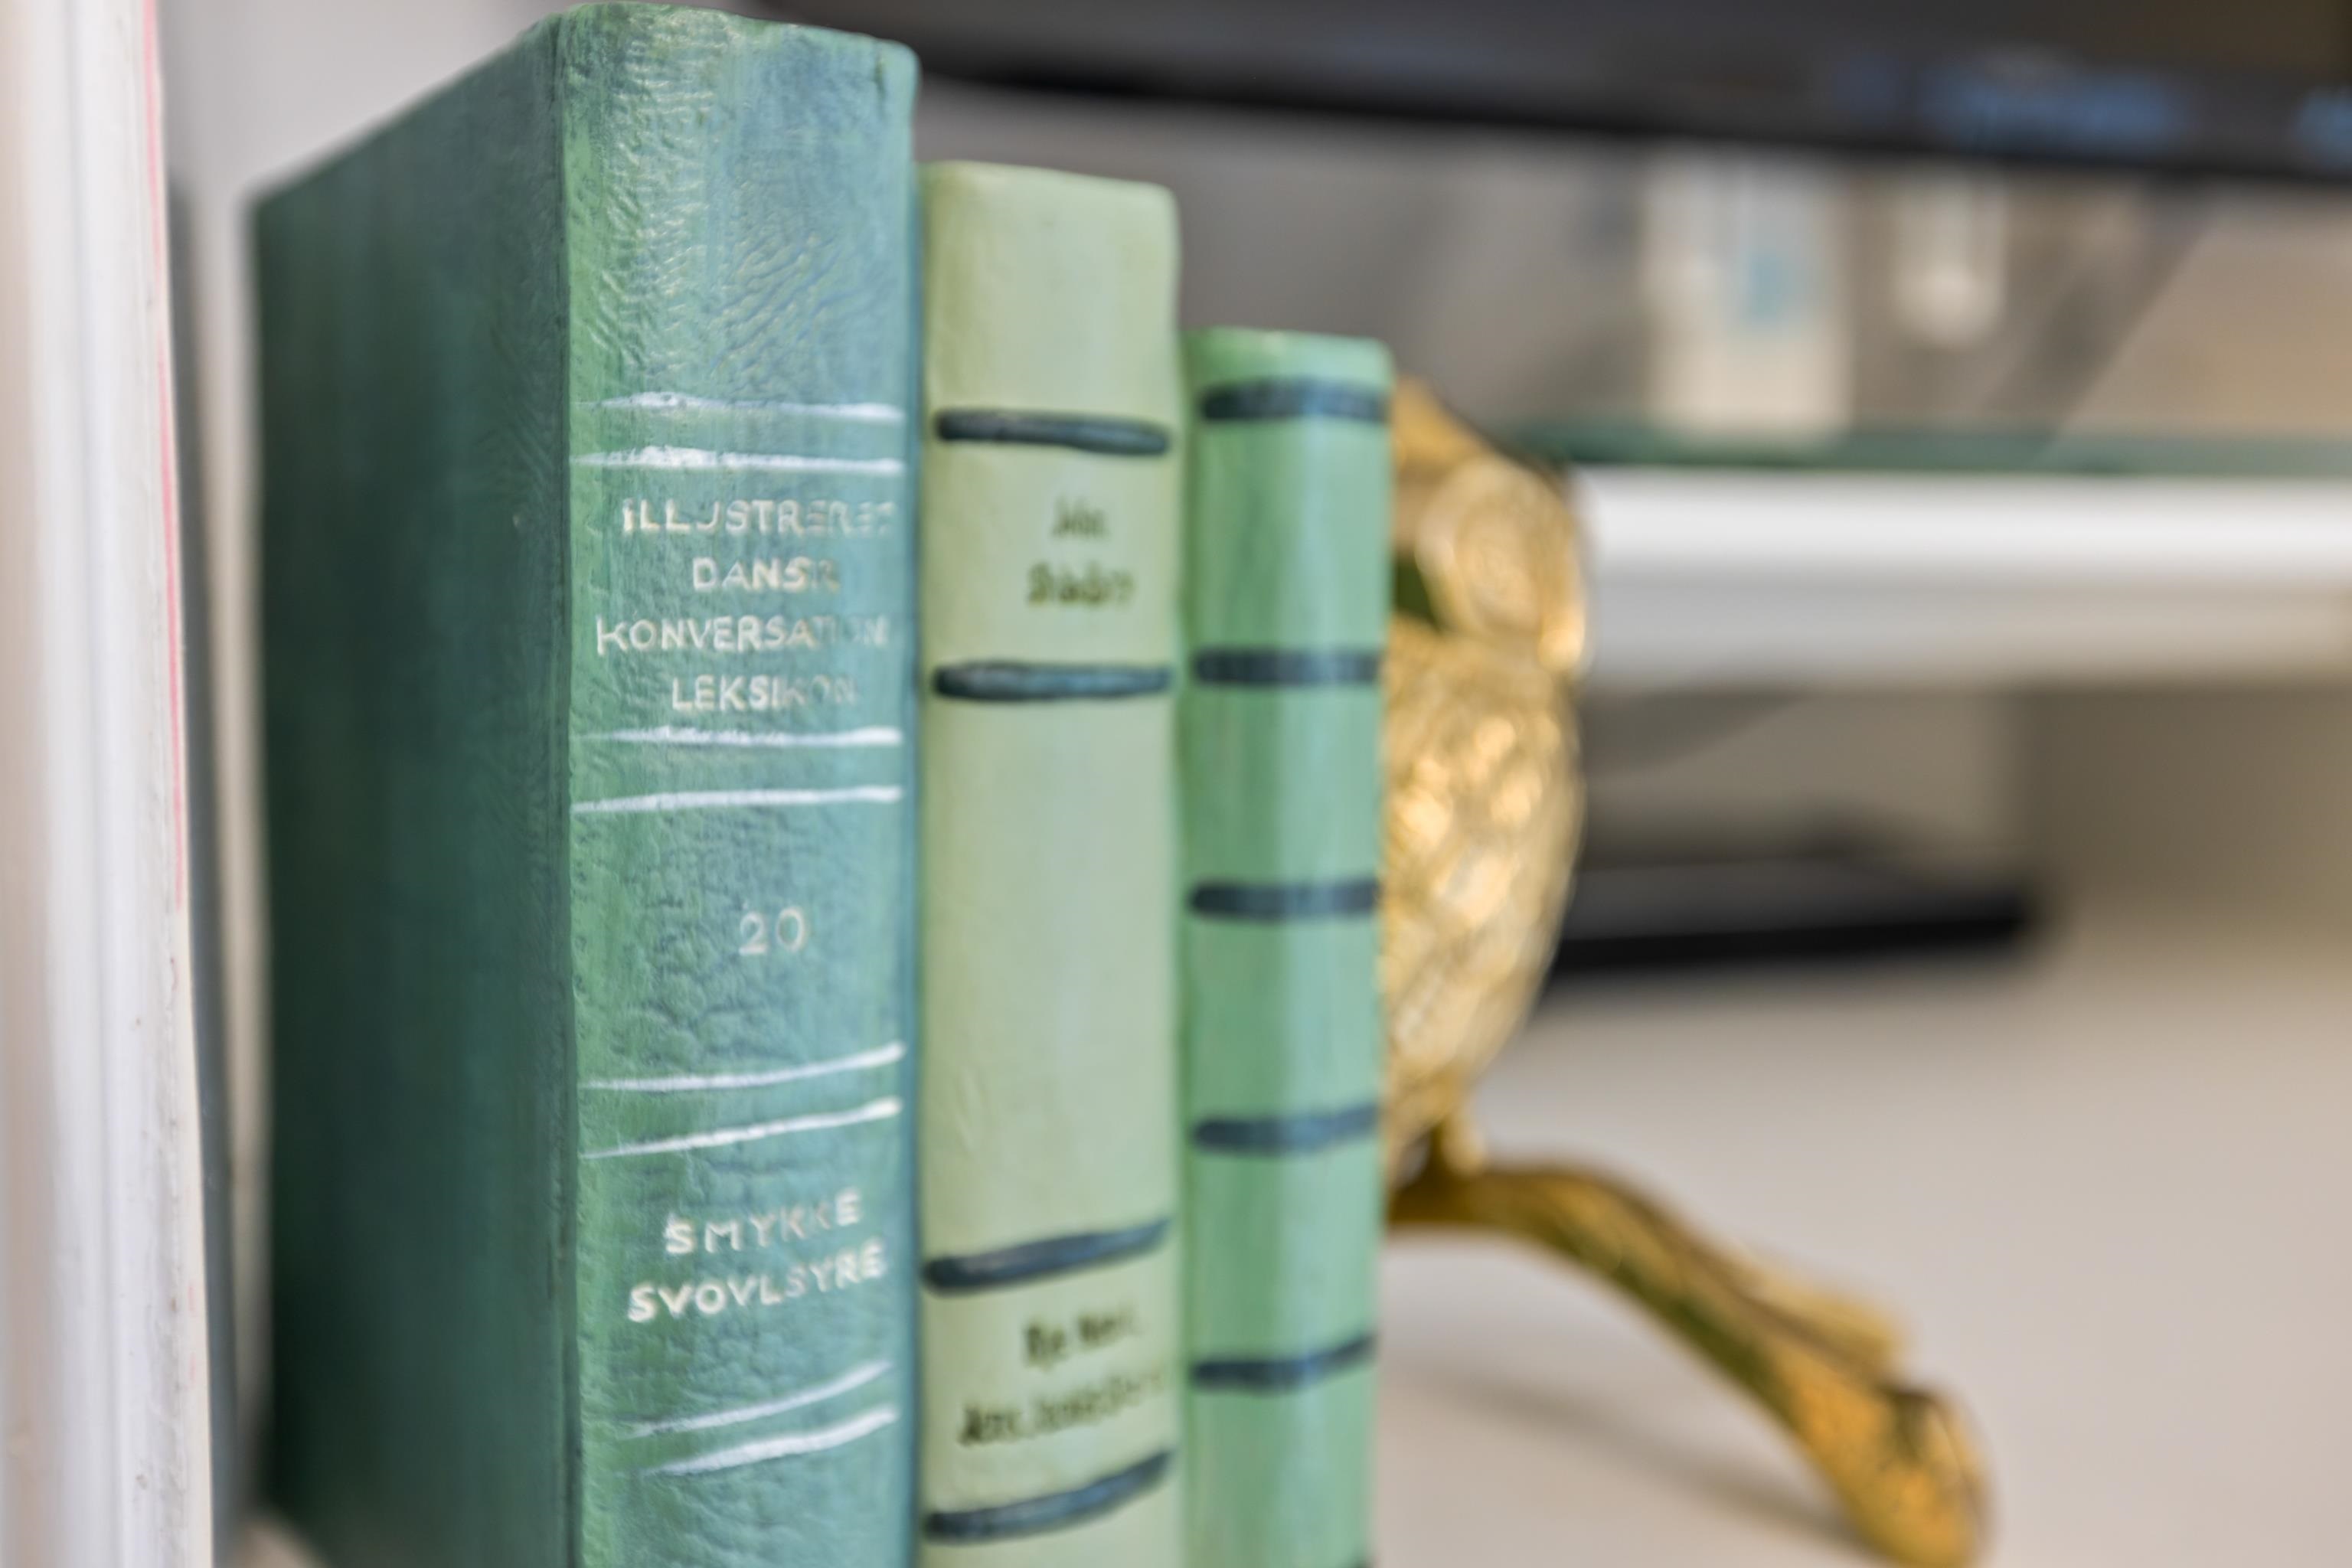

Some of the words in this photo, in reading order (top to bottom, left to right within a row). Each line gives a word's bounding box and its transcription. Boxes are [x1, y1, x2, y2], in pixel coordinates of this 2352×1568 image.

[738, 907, 805, 956] 20
[665, 1187, 861, 1254] SMYKKE
[627, 1237, 887, 1323] SVOVLSYRE
